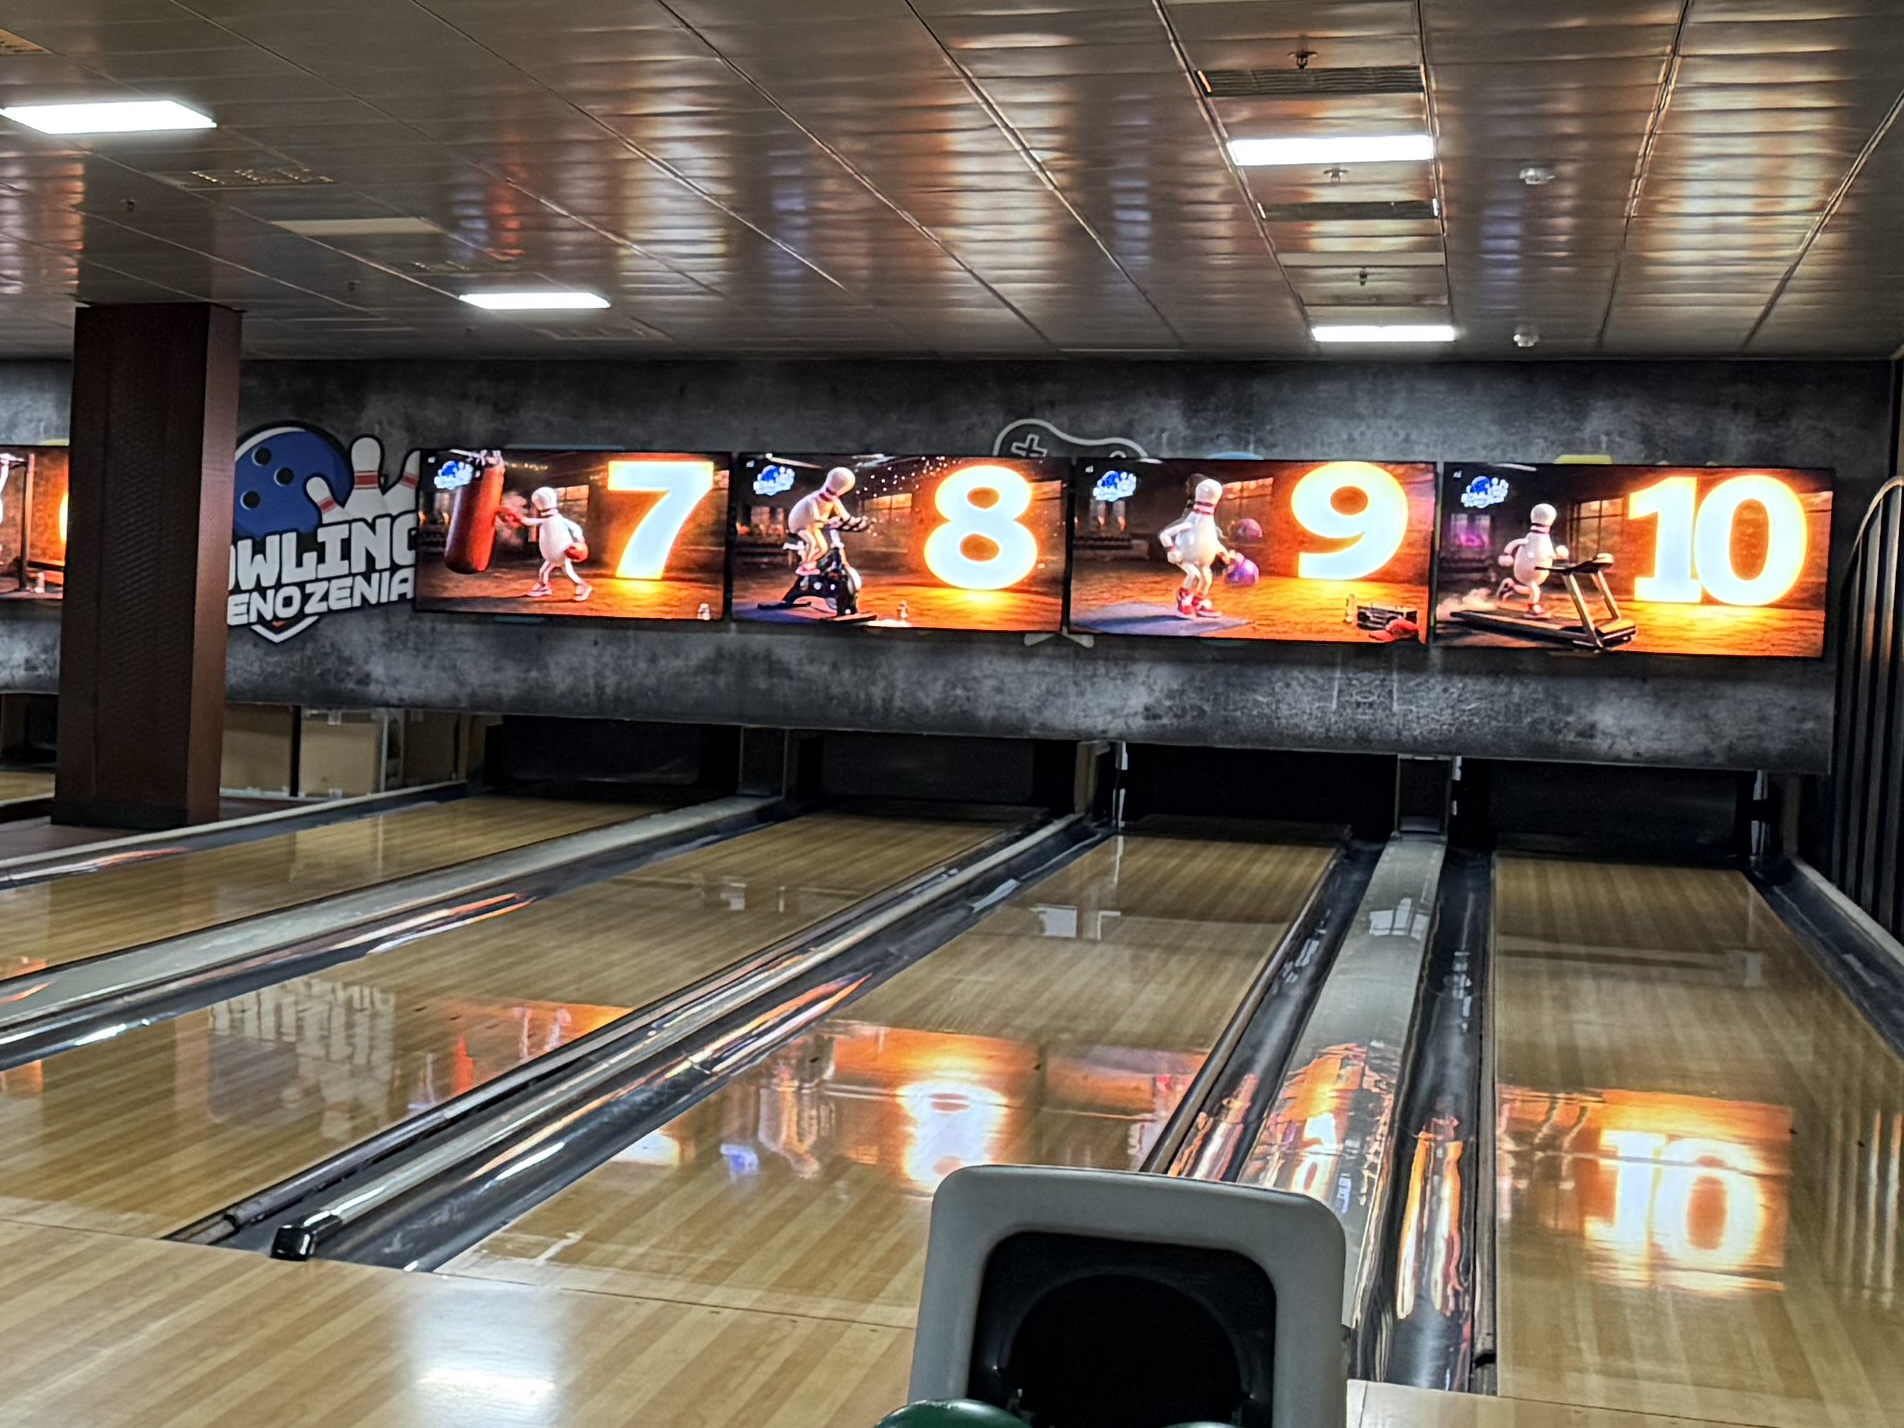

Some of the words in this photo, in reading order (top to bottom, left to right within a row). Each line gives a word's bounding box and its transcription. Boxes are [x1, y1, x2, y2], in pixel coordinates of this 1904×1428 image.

[607, 460, 715, 581] 7
[921, 463, 1041, 592] 8
[1288, 460, 1411, 582] 9
[1625, 471, 1810, 608] 10
